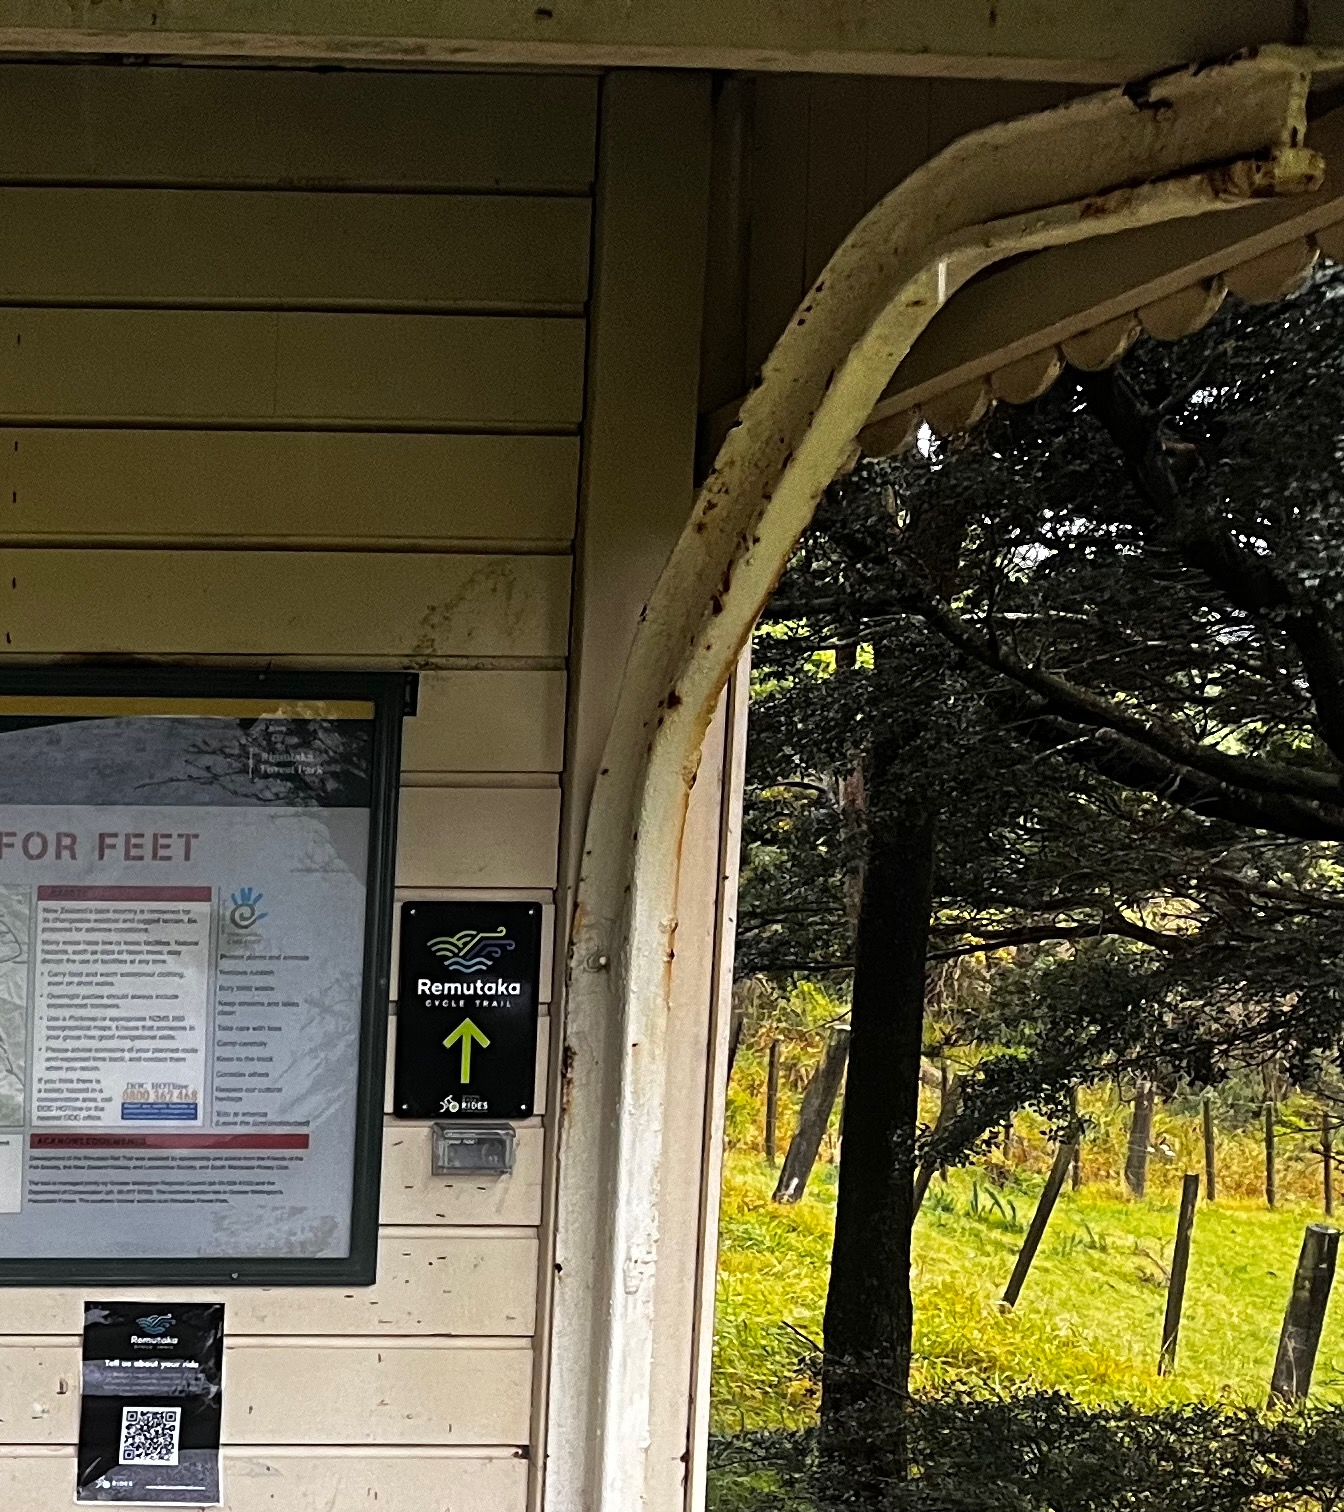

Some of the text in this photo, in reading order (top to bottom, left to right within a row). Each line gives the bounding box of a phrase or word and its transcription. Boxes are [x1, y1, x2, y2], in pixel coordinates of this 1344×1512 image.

[97, 831, 200, 862] FEET
[418, 978, 521, 996] Remutaka
[131, 1336, 178, 1344] Remutaka
[161, 1361, 180, 1369] your
